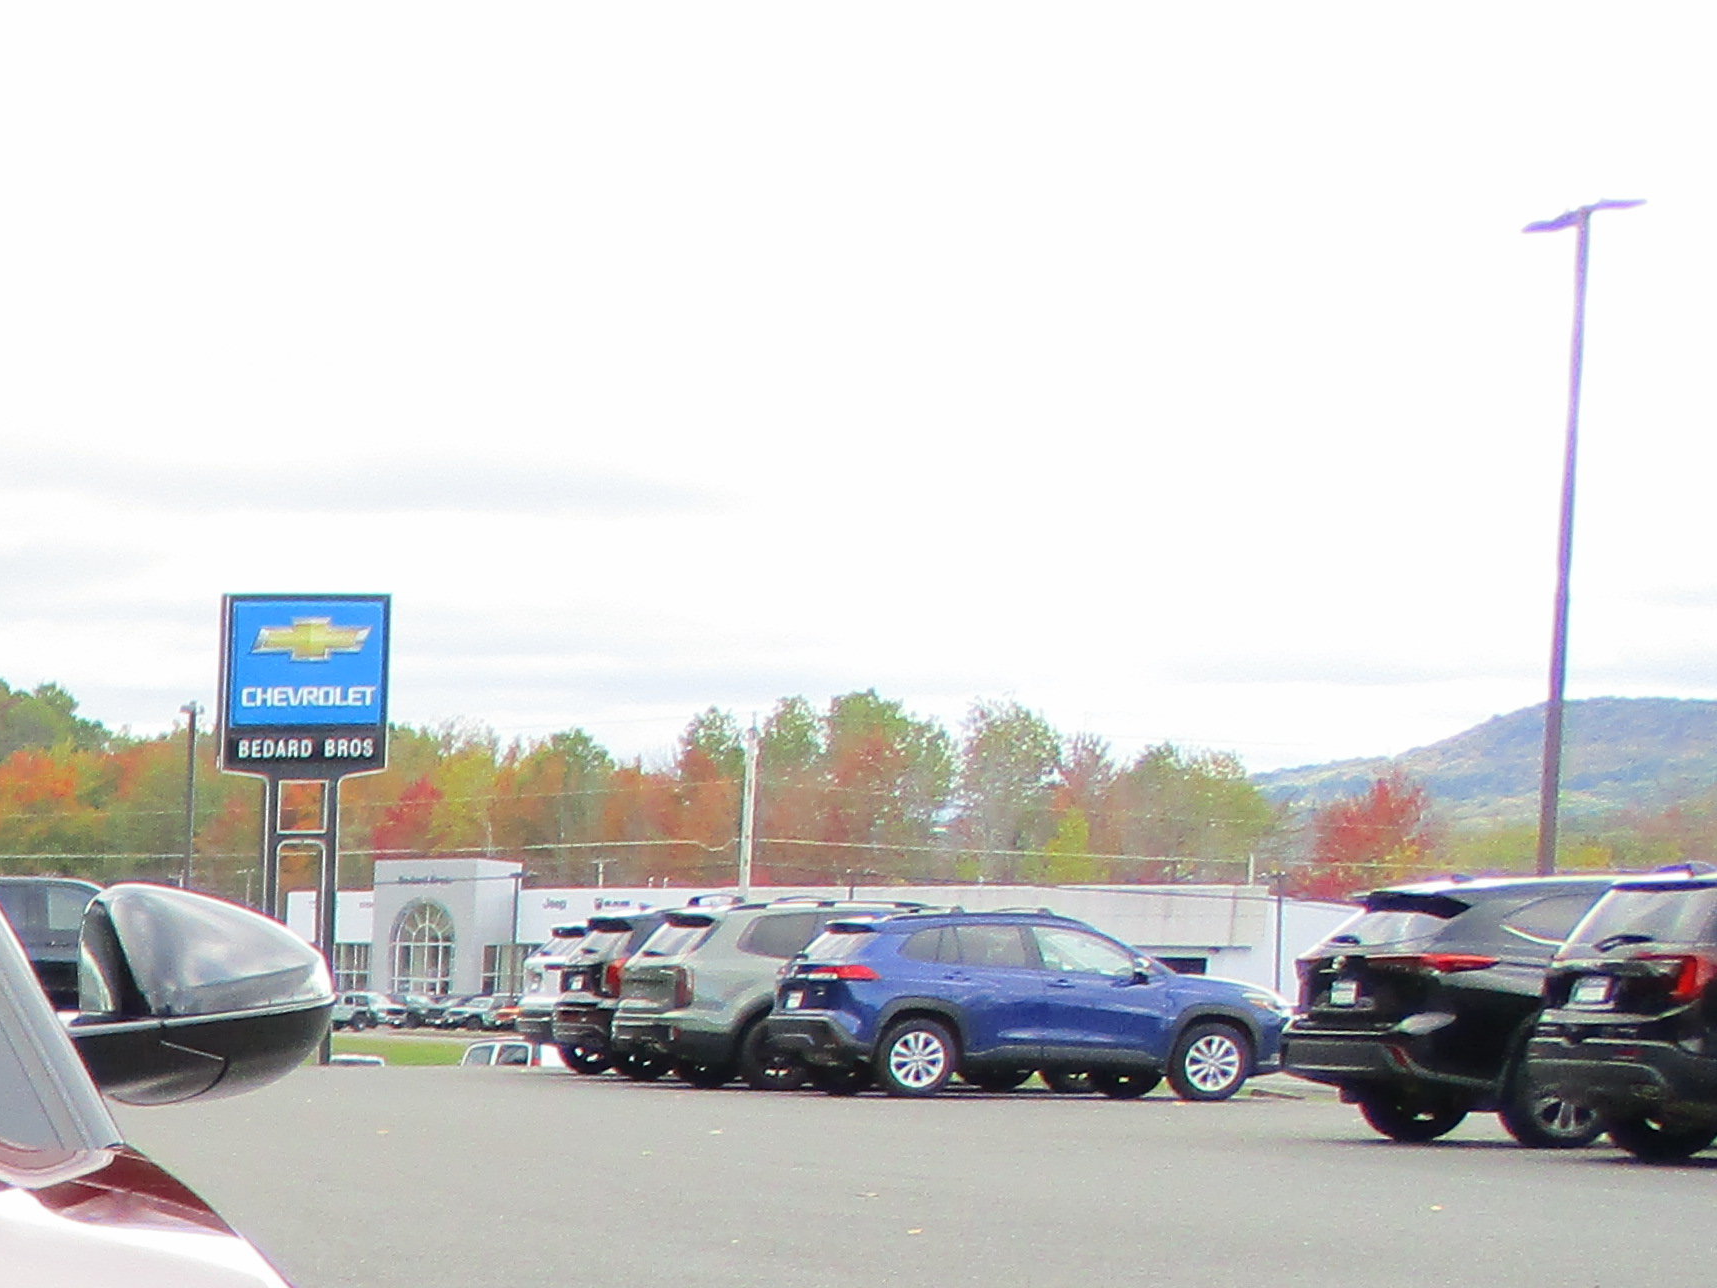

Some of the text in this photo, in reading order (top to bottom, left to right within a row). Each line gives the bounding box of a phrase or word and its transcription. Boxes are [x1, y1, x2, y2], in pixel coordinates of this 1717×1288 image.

[240, 685, 377, 707] CHEVROLET
[237, 737, 374, 759] BEDARD BROS
